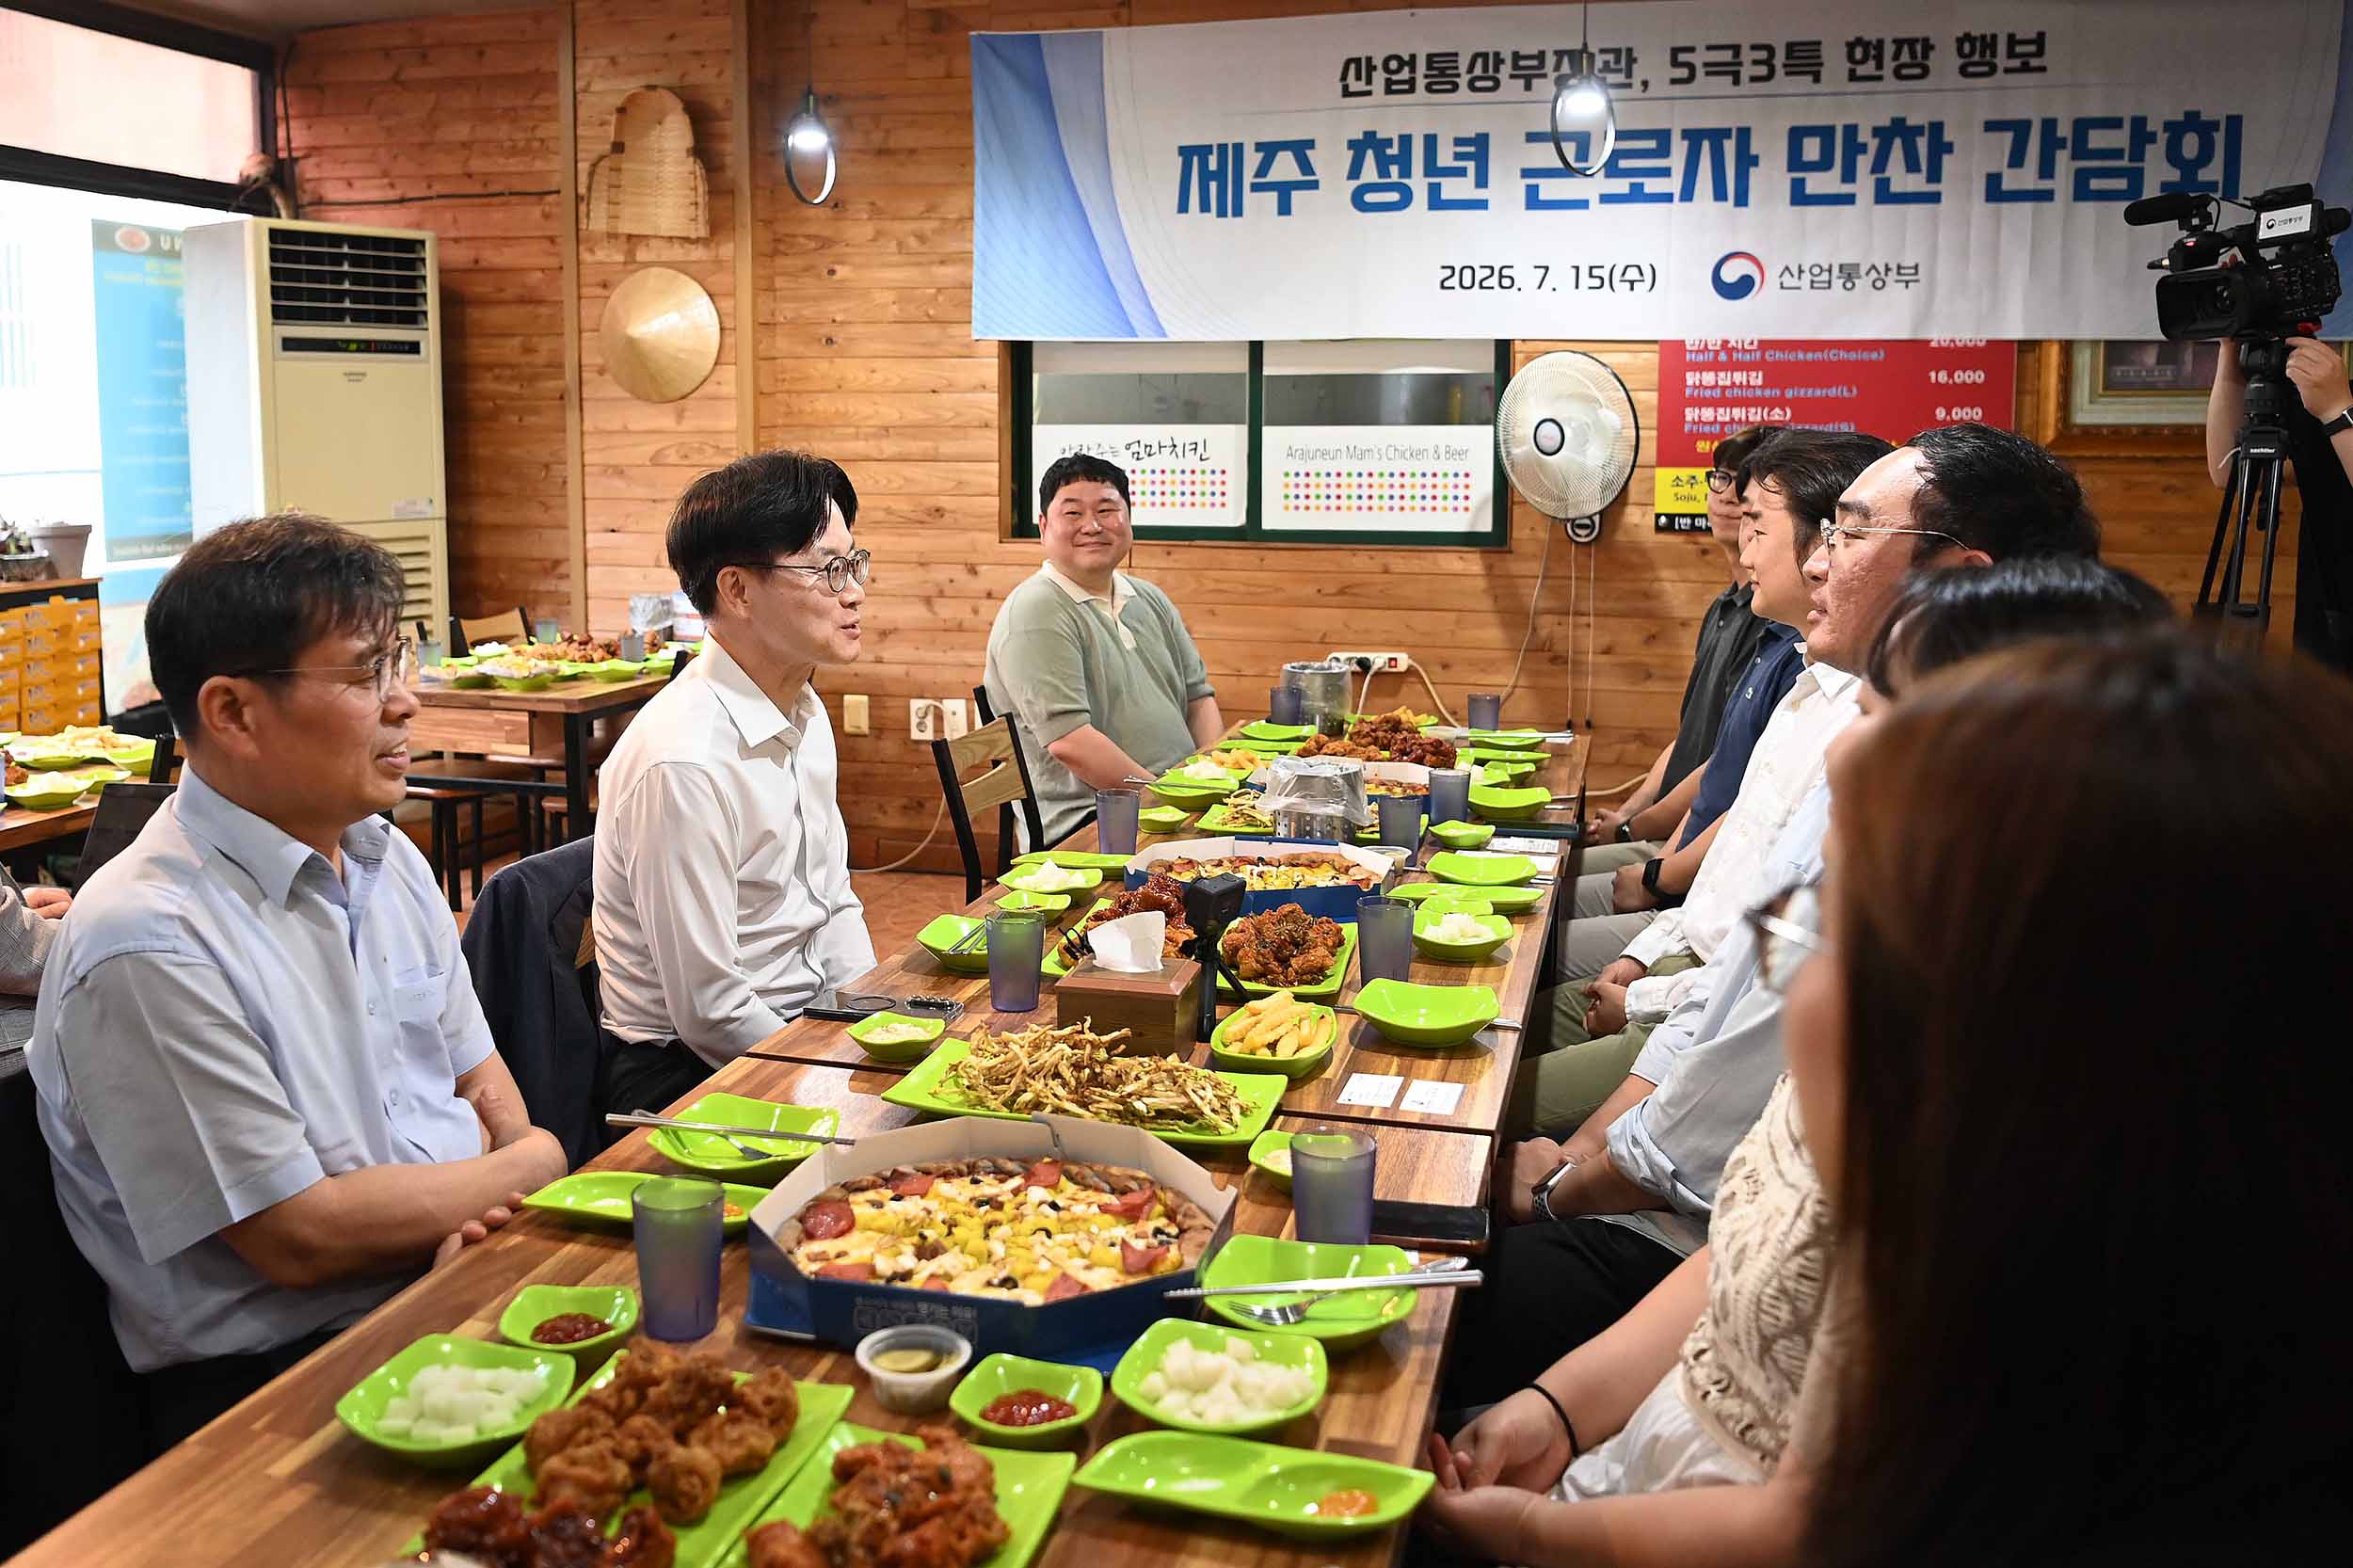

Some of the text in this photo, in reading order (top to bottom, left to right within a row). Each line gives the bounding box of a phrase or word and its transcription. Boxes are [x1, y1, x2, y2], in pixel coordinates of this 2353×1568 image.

[1668, 39, 1826, 88] 5극3특
[1843, 35, 1936, 83] 현장
[1954, 29, 2049, 80] 행보
[1176, 109, 2244, 218] 제주 청년 근로자 만찬 간담회
[1439, 263, 1657, 294] 2026. 7. 15(수)
[1778, 262, 1921, 293] 산업통상부
[1686, 349, 1715, 362] Half
[1733, 349, 1763, 362] Half
[1686, 386, 1721, 398] Fried
[1724, 386, 1781, 399] chicken
[1685, 422, 1721, 434] Fried
[1125, 436, 1210, 462] 엄마치킨
[1286, 444, 1469, 463] Arajuneun Mam's Chicken & Beer
